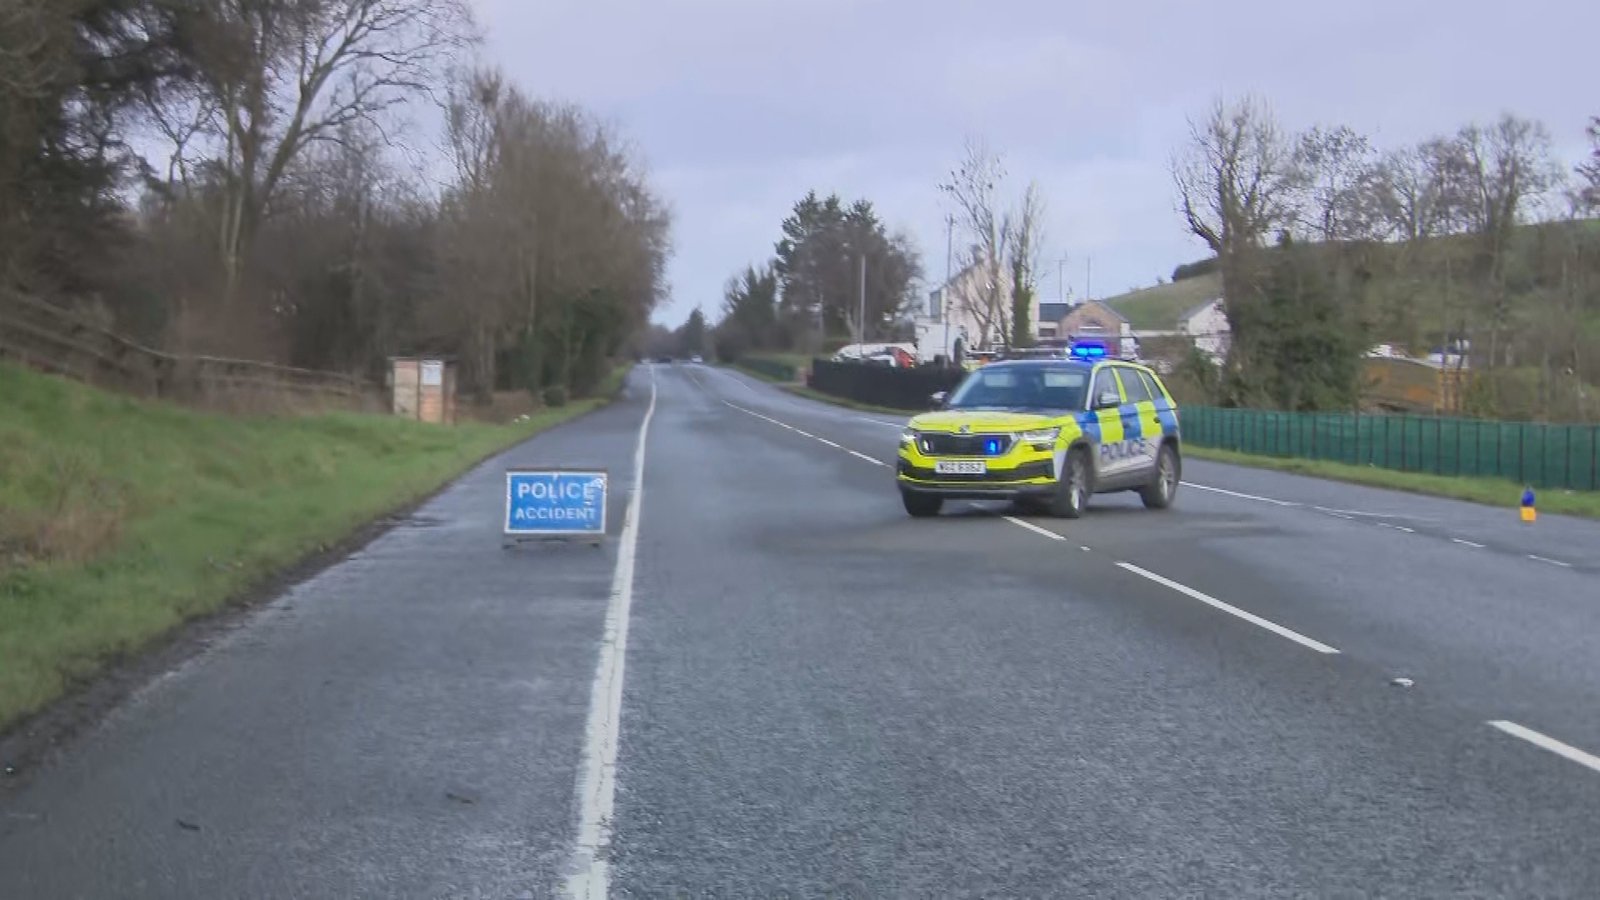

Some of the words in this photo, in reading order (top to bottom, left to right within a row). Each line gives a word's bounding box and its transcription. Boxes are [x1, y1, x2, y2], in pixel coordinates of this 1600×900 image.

[1100, 437, 1148, 460] POLICE
[517, 482, 595, 499] POLICE
[515, 507, 596, 520] ACCIDENT
